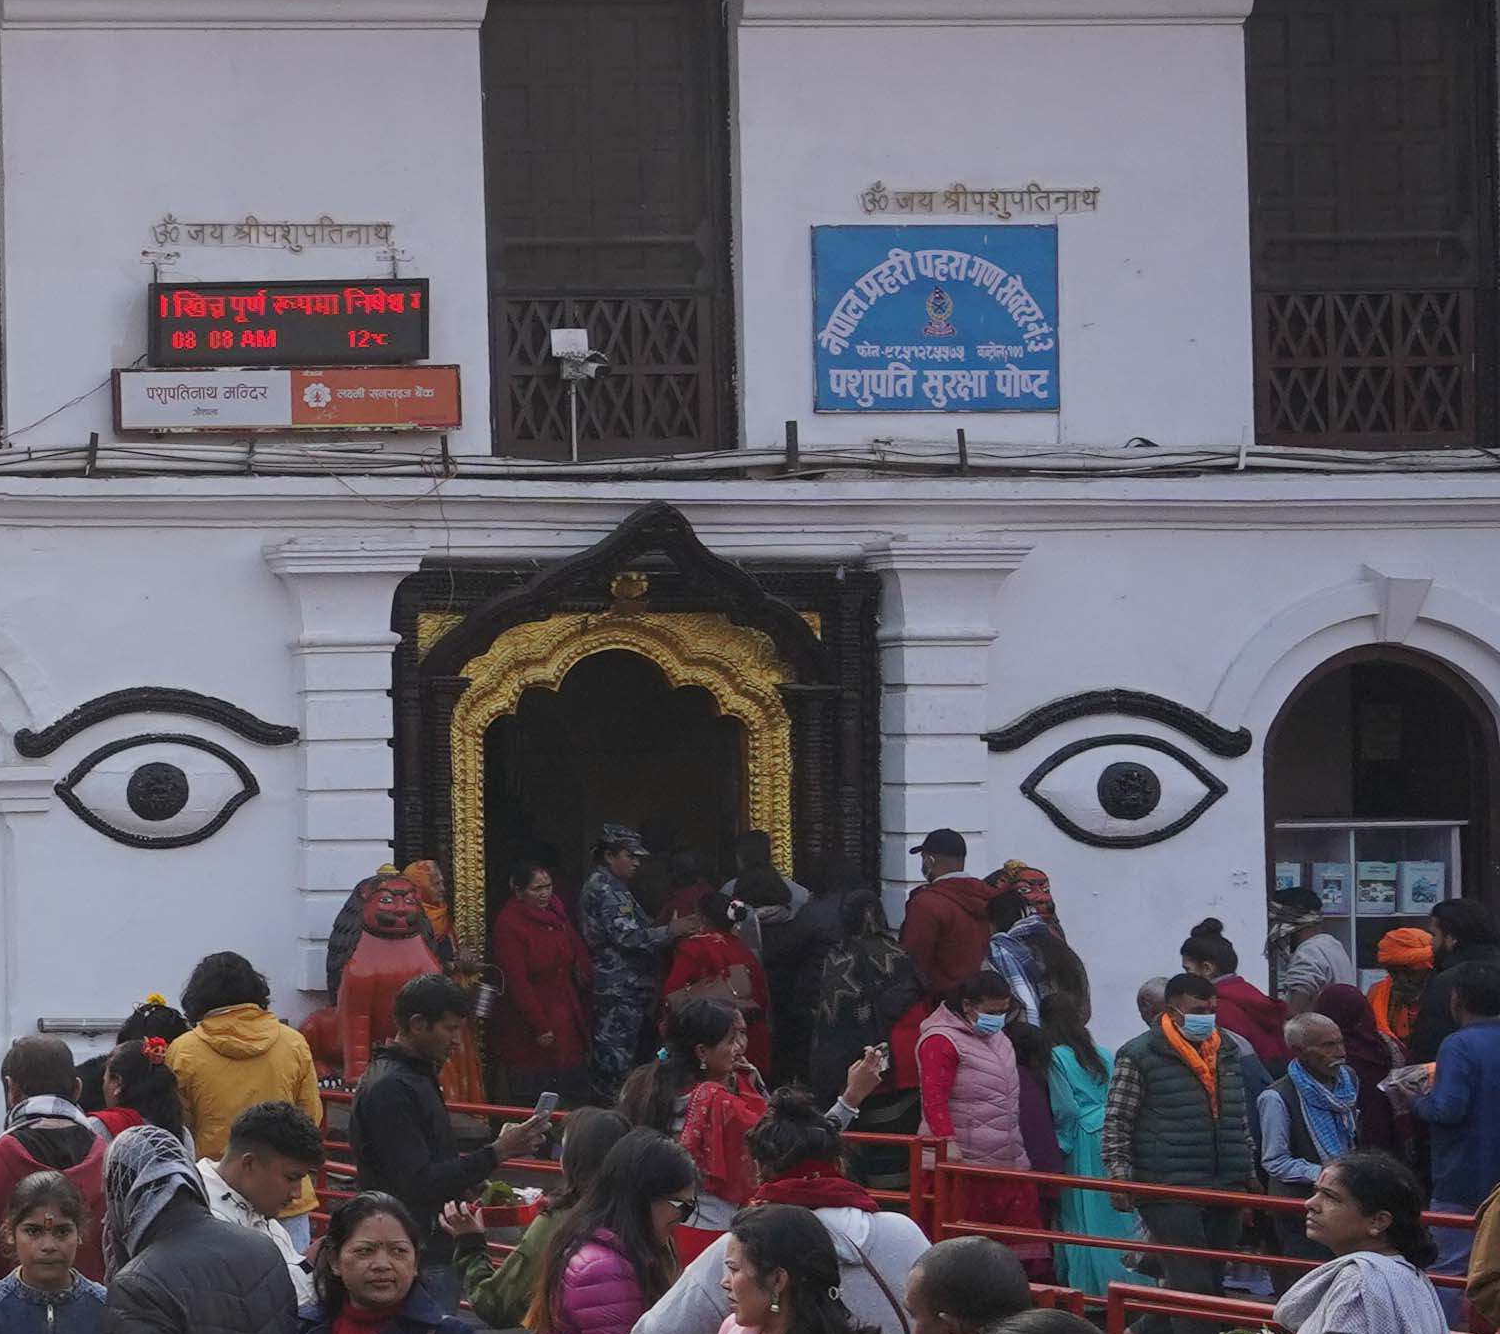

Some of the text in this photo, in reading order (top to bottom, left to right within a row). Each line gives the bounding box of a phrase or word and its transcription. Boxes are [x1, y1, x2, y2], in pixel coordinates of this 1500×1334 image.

[894, 190, 938, 212] जय
[186, 223, 224, 244] जय
[228, 290, 268, 323] पूर्ण
[343, 287, 405, 315] निषेध
[817, 288, 870, 356] नेपाल
[854, 247, 917, 306] प्रहरी
[914, 249, 972, 282] पहरा
[967, 255, 1009, 296] गण
[240, 329, 277, 349] AM
[146, 383, 268, 405] पशुपतिनाथ मन्दिर
[829, 362, 1050, 408] पशुपति सुरक्षा पोष्ट
